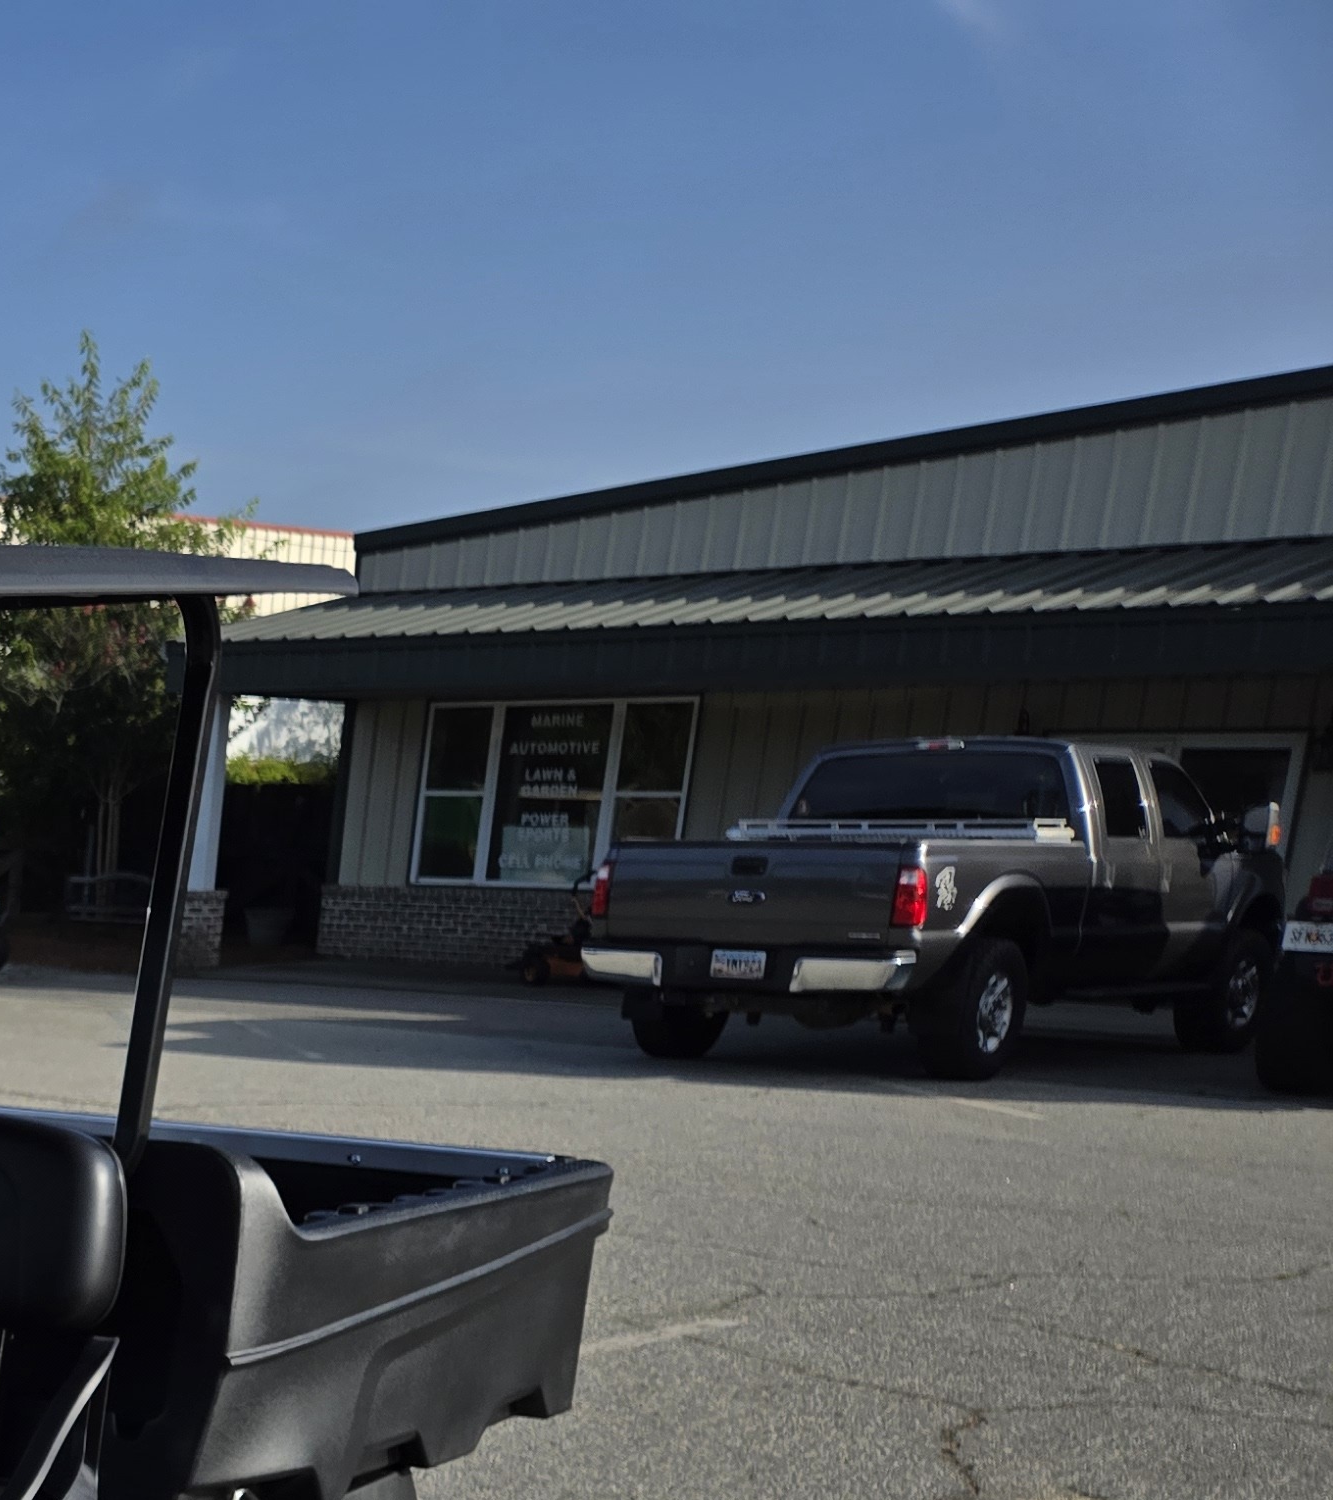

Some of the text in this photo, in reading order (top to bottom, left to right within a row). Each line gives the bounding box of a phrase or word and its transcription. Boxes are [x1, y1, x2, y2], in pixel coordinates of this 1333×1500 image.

[530, 712, 584, 728] MARINE
[509, 740, 600, 755] AUTOMOTIVE
[524, 767, 577, 782] LAWN &
[519, 783, 578, 799] GARDEN
[520, 811, 569, 826] POWER
[517, 827, 570, 843] SPORTS
